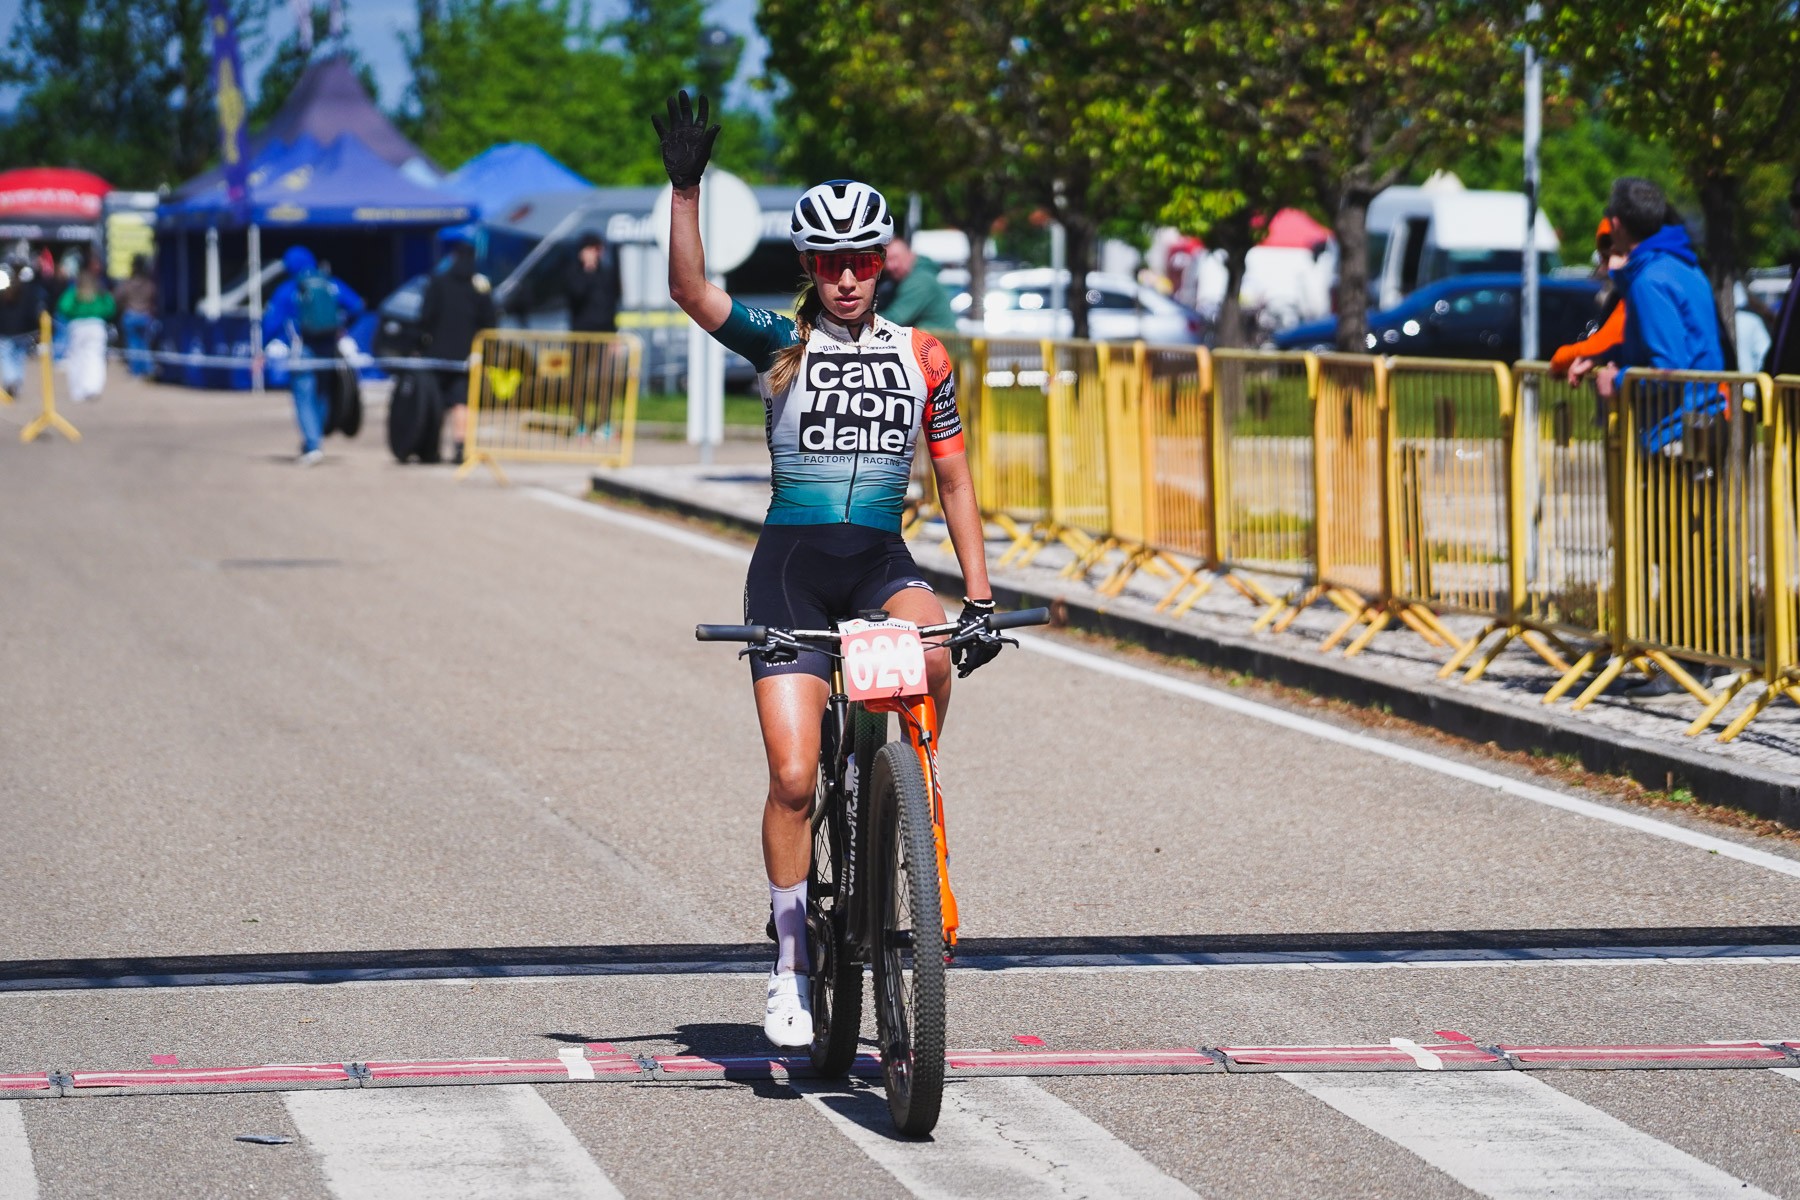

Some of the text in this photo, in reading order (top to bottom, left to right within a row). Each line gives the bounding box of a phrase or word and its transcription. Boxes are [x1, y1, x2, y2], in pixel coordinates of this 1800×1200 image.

[809, 361, 907, 389] can
[815, 389, 912, 426] non
[802, 417, 906, 453] dale
[803, 455, 900, 466] FACTORY RACING
